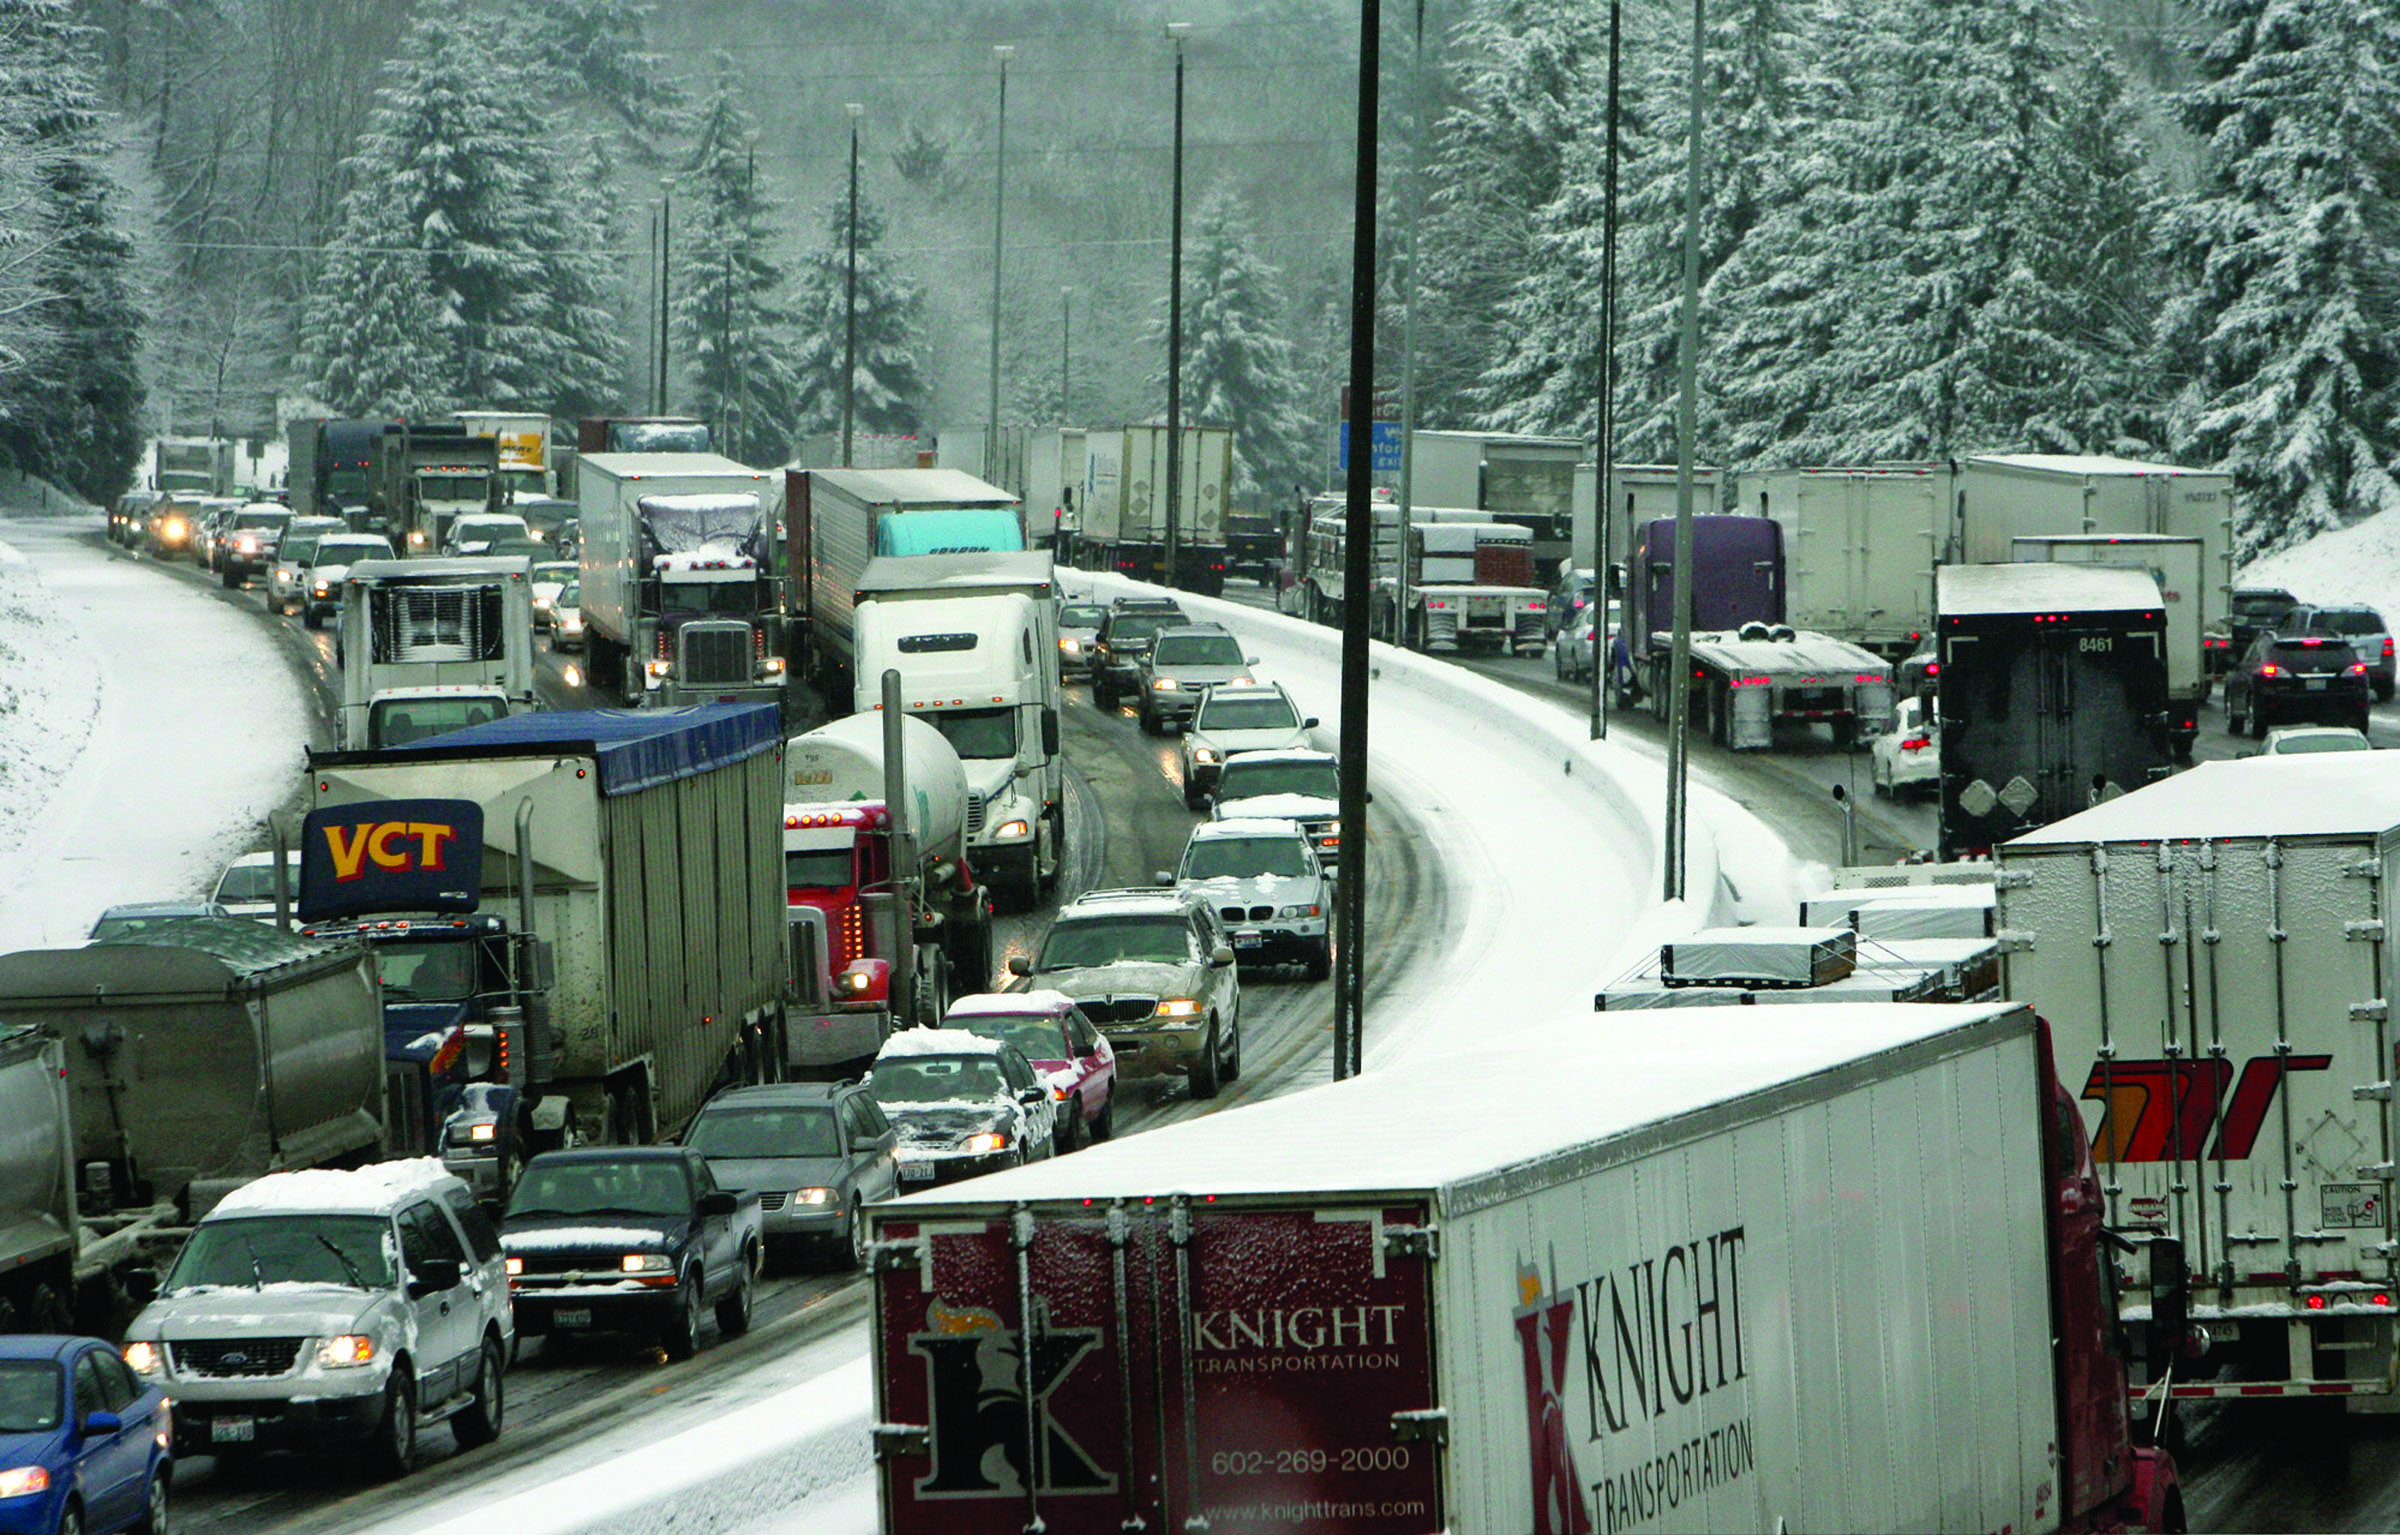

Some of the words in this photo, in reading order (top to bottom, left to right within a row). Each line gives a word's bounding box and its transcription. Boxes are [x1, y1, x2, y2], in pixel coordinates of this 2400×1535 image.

[2079, 636, 2112, 652] 8461
[322, 820, 457, 883] VCT
[1193, 1304, 1406, 1351] KNIGHT
[1577, 1224, 1748, 1444] KNIGHT
[1194, 1353, 1400, 1374] TRANSPORTATION
[1212, 1446, 1410, 1475] 602-269-2000
[1592, 1417, 1754, 1535] TRANSPORTATION
[1206, 1500, 1425, 1523] www.knighttrans.com
